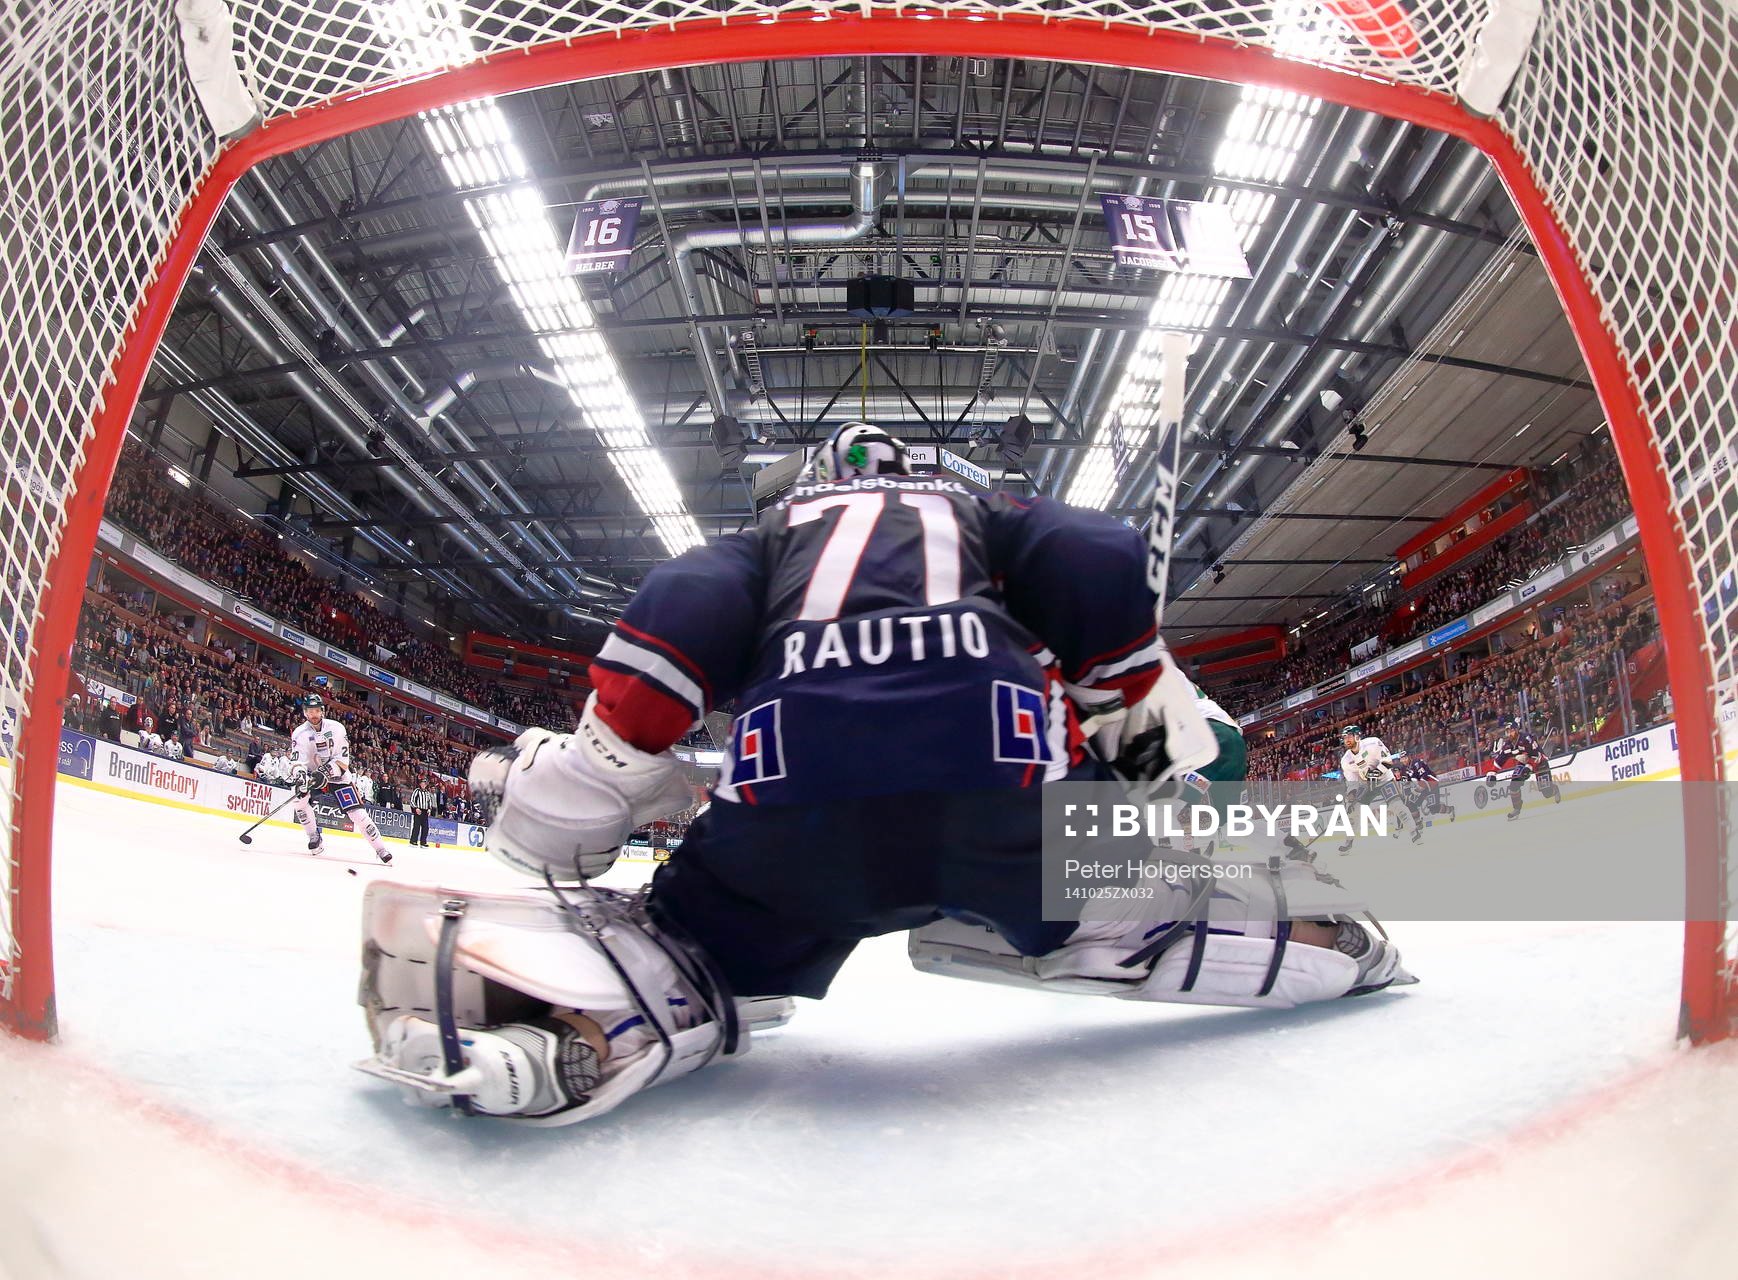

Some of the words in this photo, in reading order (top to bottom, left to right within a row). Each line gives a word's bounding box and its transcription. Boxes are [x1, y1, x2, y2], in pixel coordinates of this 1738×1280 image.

[584, 217, 622, 246] 16
[1120, 213, 1158, 242] 15
[574, 260, 615, 273] HELBER
[943, 451, 988, 486] Corren
[787, 492, 961, 621] 71
[779, 611, 990, 680] RAUTIO
[1605, 735, 1650, 762] ActiPro
[108, 751, 199, 800] BrandFactory
[1612, 757, 1647, 782] Event
[227, 794, 271, 816] SPORTIA
[244, 781, 273, 802] TEAM
